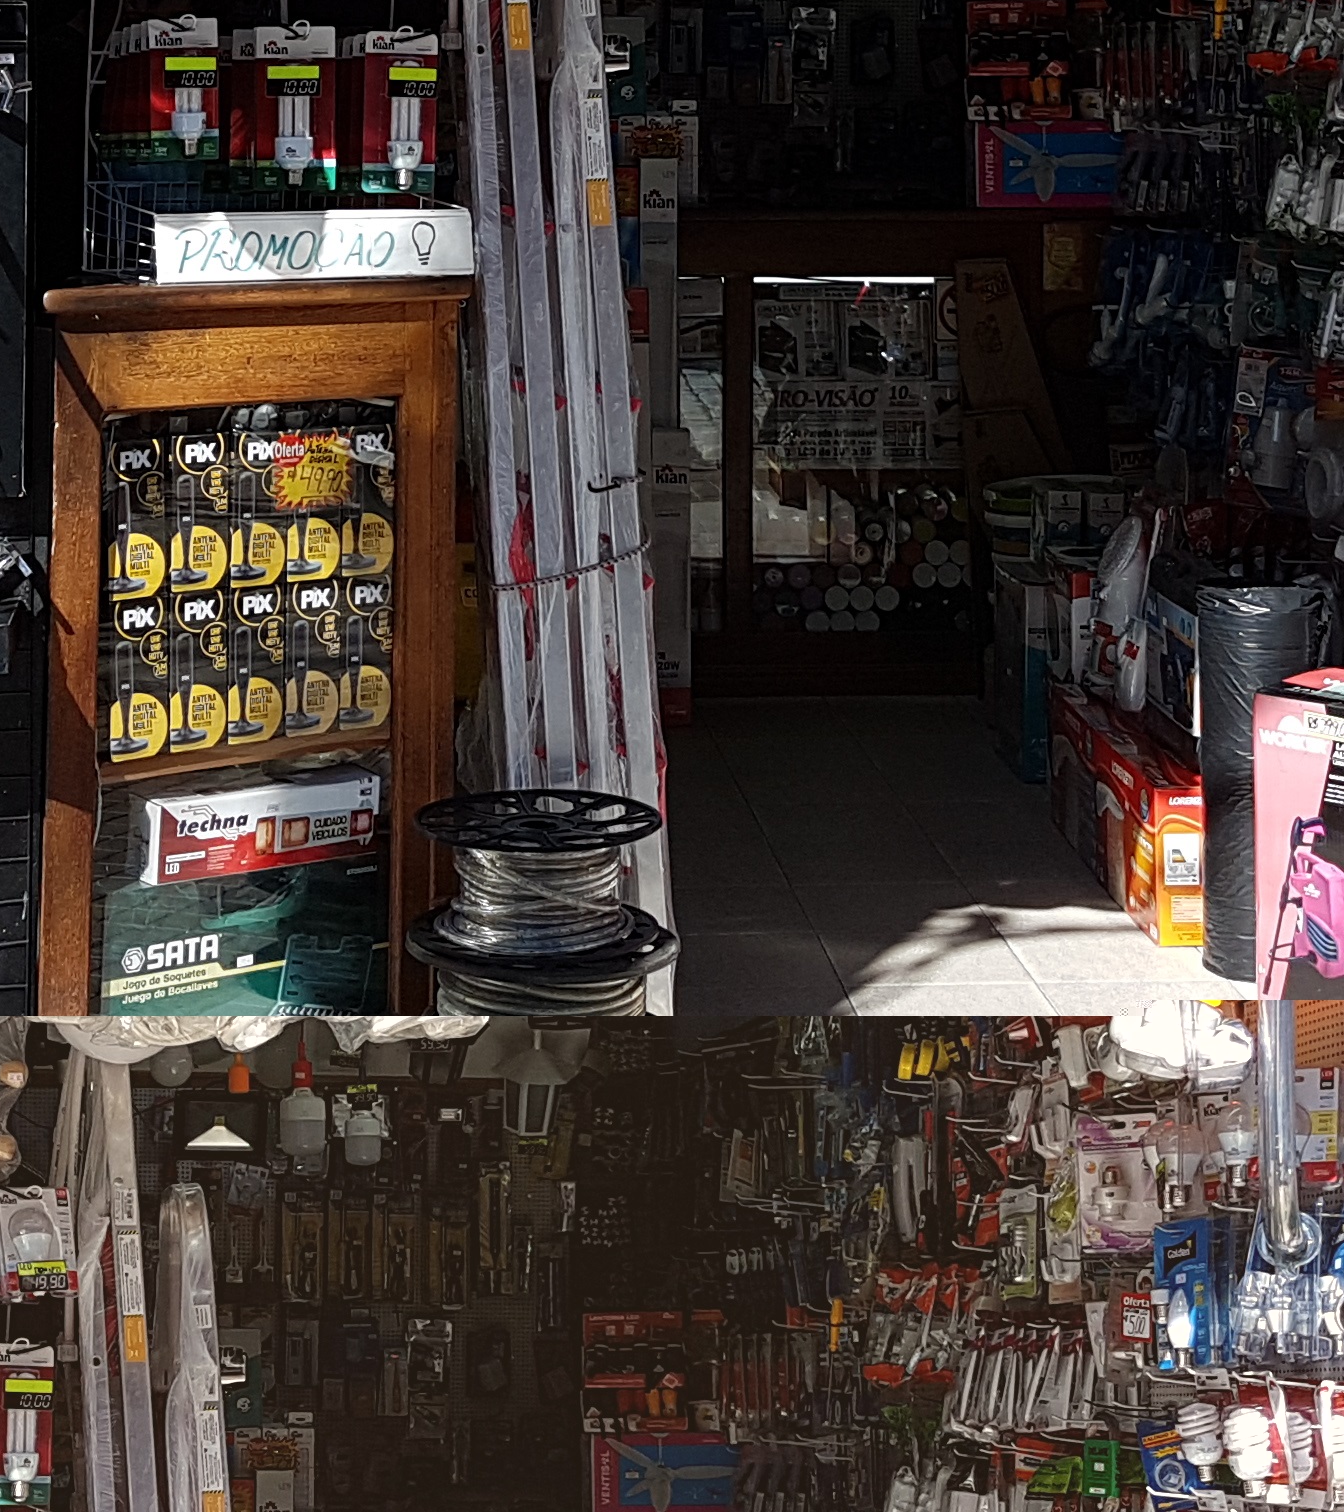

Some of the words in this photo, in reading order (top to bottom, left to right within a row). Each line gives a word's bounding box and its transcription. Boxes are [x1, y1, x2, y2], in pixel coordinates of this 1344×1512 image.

[155, 31, 184, 47] kian
[264, 41, 289, 56] kian
[642, 189, 676, 209] kian
[274, 441, 305, 458] Oferta
[655, 464, 688, 484] kian
[1258, 728, 1333, 754] WORKER
[177, 813, 249, 836] techna
[313, 815, 348, 829] CUIDADO
[165, 861, 180, 874] LED
[146, 933, 219, 970] SATA
